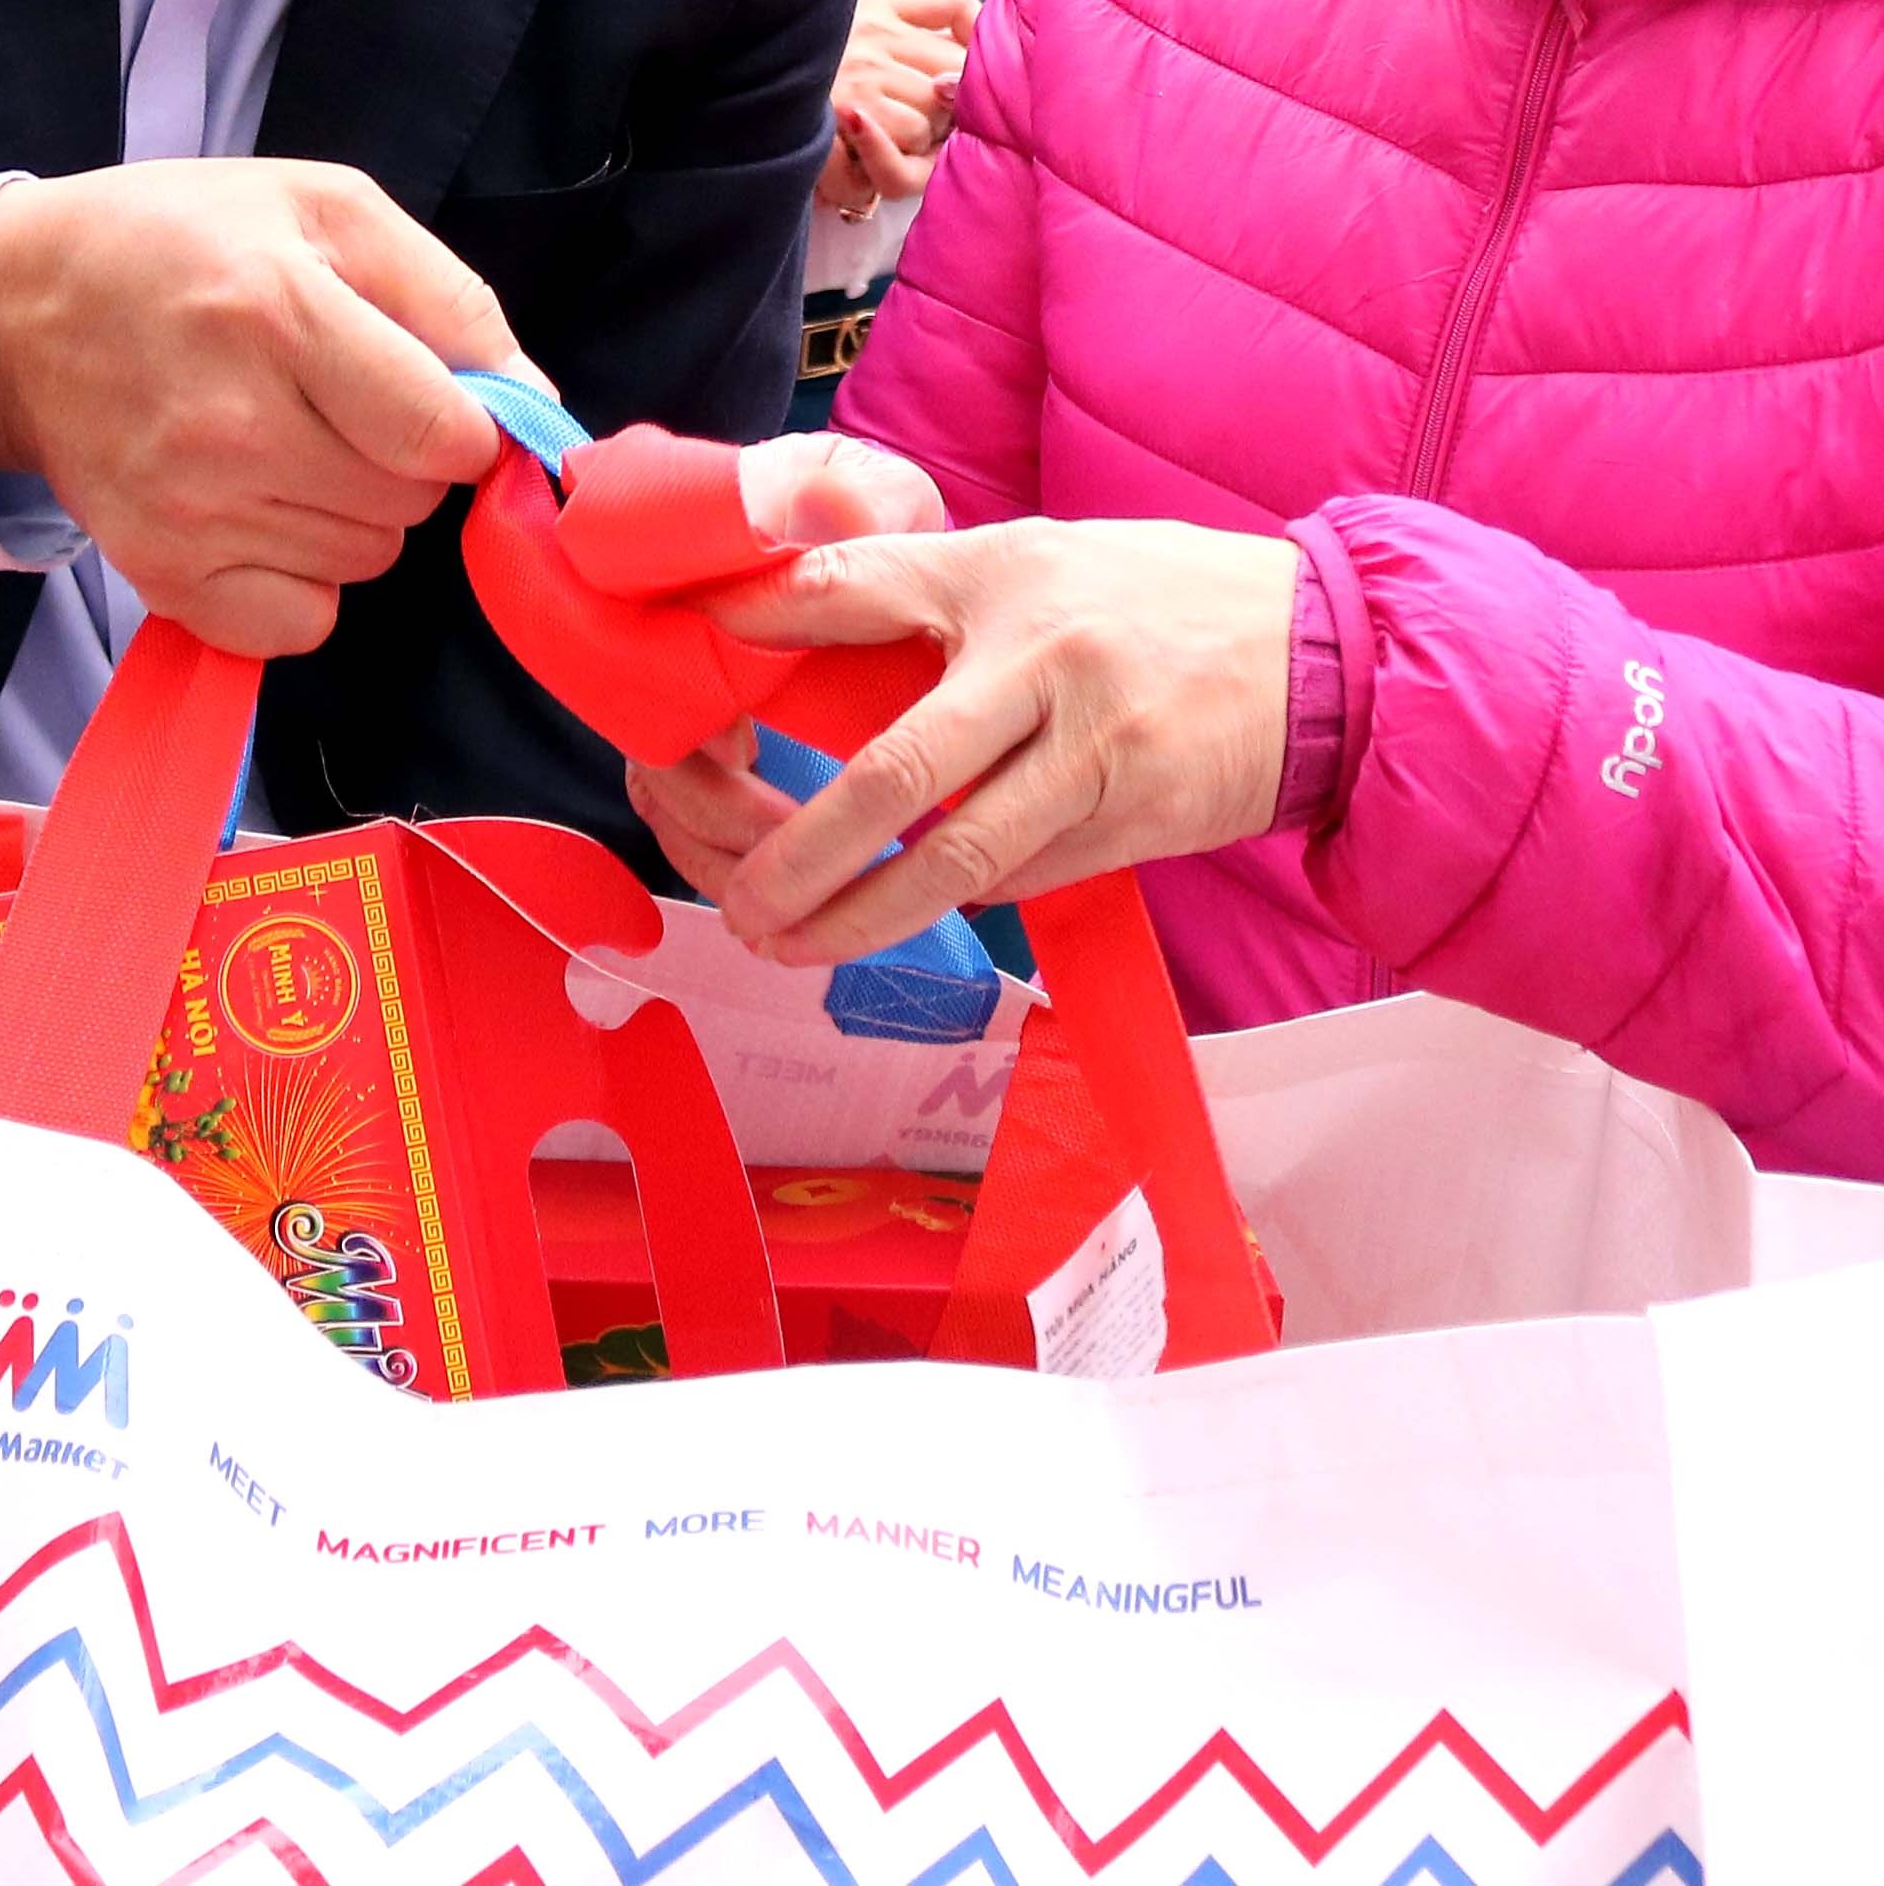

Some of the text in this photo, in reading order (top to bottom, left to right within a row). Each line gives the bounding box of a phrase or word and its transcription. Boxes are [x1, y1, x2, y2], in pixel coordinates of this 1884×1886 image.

[1601, 660, 1665, 799] yody
[180, 948, 218, 1057] HÀ NỘI
[268, 943, 297, 1005] MINH
[209, 1440, 1263, 1614] MEET MAGNIFICENT MORE MANNER MEANINGFUL
